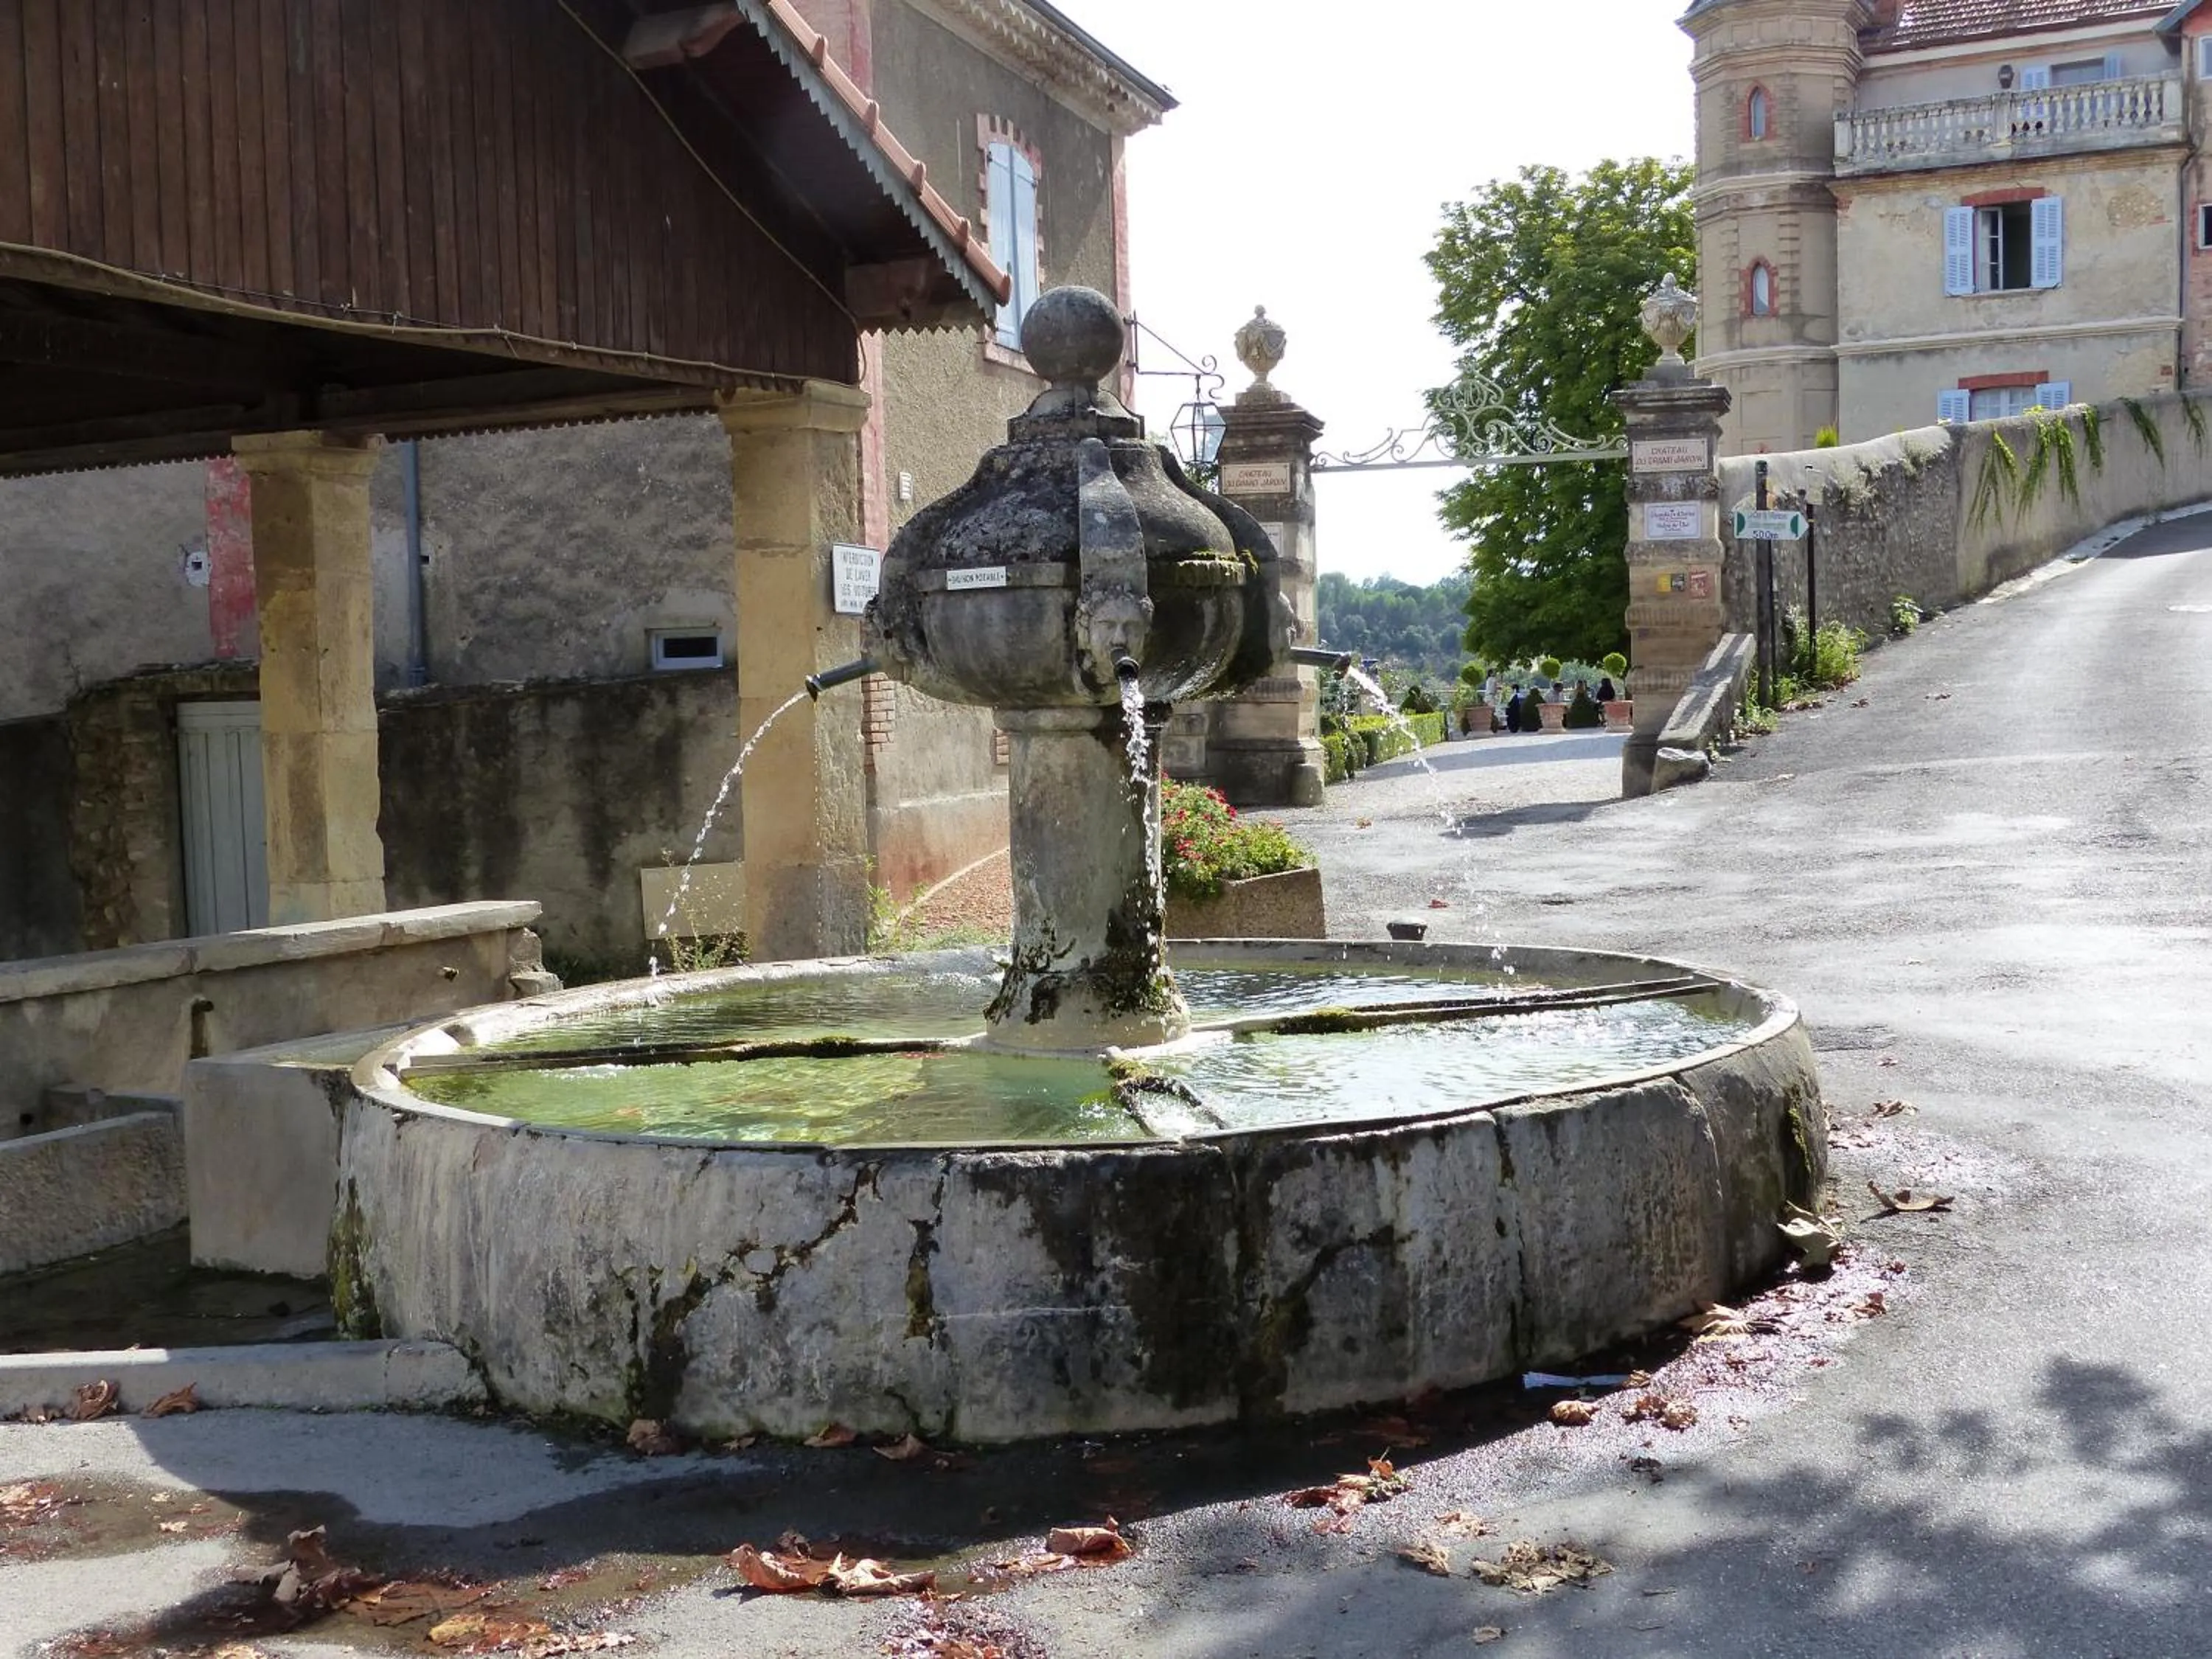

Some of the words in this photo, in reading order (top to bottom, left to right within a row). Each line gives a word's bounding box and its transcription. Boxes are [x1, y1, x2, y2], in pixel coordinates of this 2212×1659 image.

[1651, 446, 1688, 455] CHATEAU
[1648, 456, 1672, 465] GRAND
[1674, 454, 1703, 464] JARDIN
[1238, 470, 1272, 479] CHATEAU
[1237, 479, 1259, 487] GRAND
[1260, 477, 1287, 486] JARDIN
